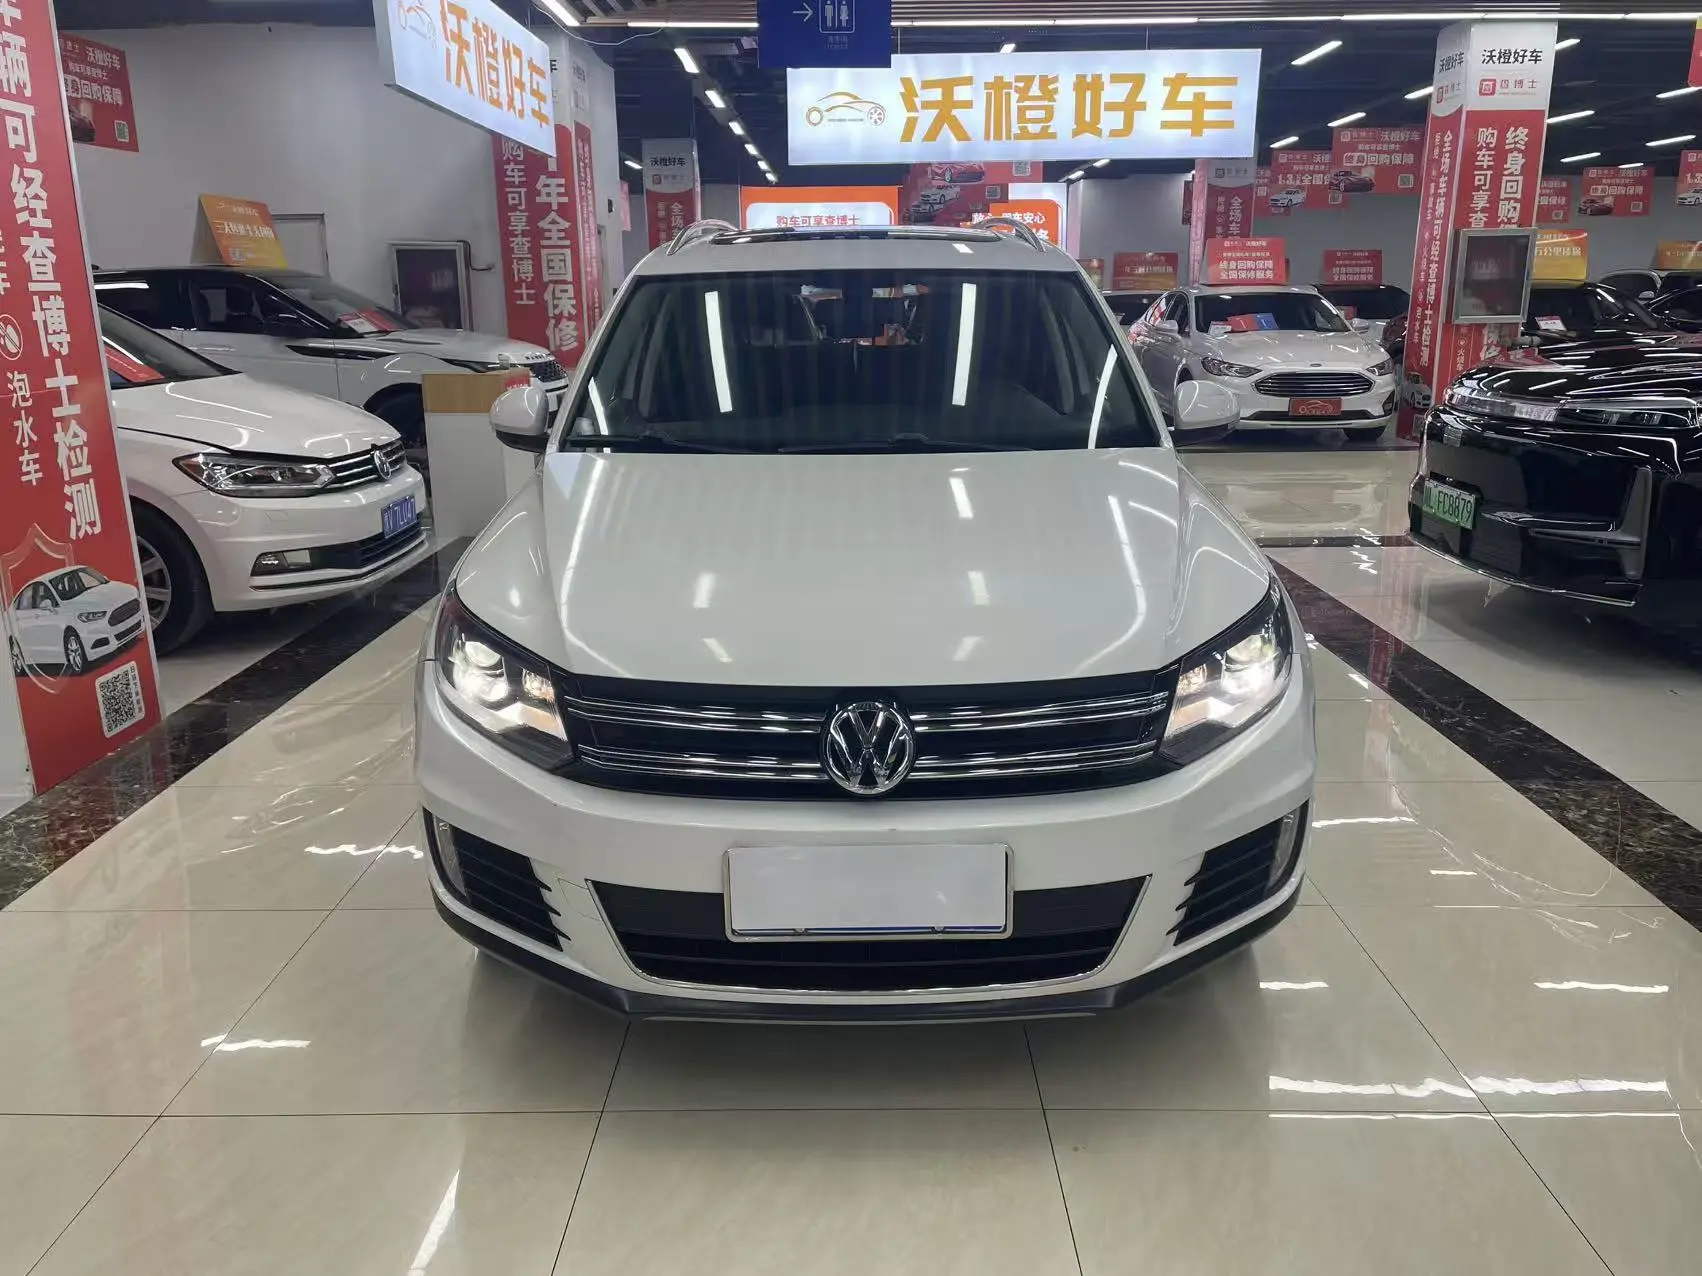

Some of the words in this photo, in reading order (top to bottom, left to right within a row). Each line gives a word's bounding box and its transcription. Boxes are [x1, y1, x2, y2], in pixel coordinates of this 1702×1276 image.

[440, 0, 549, 128] 沃橙好车
[1438, 52, 1465, 73] 沃橙好车
[1481, 49, 1543, 65] 沃橙好车
[899, 73, 1239, 143] 沃橙好车
[651, 156, 686, 167] 沃橙好车
[1498, 126, 1529, 229] 终身回购
[502, 138, 536, 306] 购车可享查博士
[776, 215, 860, 227] 购车可享查博士
[1228, 196, 1242, 238] 全场车
[7, 371, 43, 486] 泡水车
